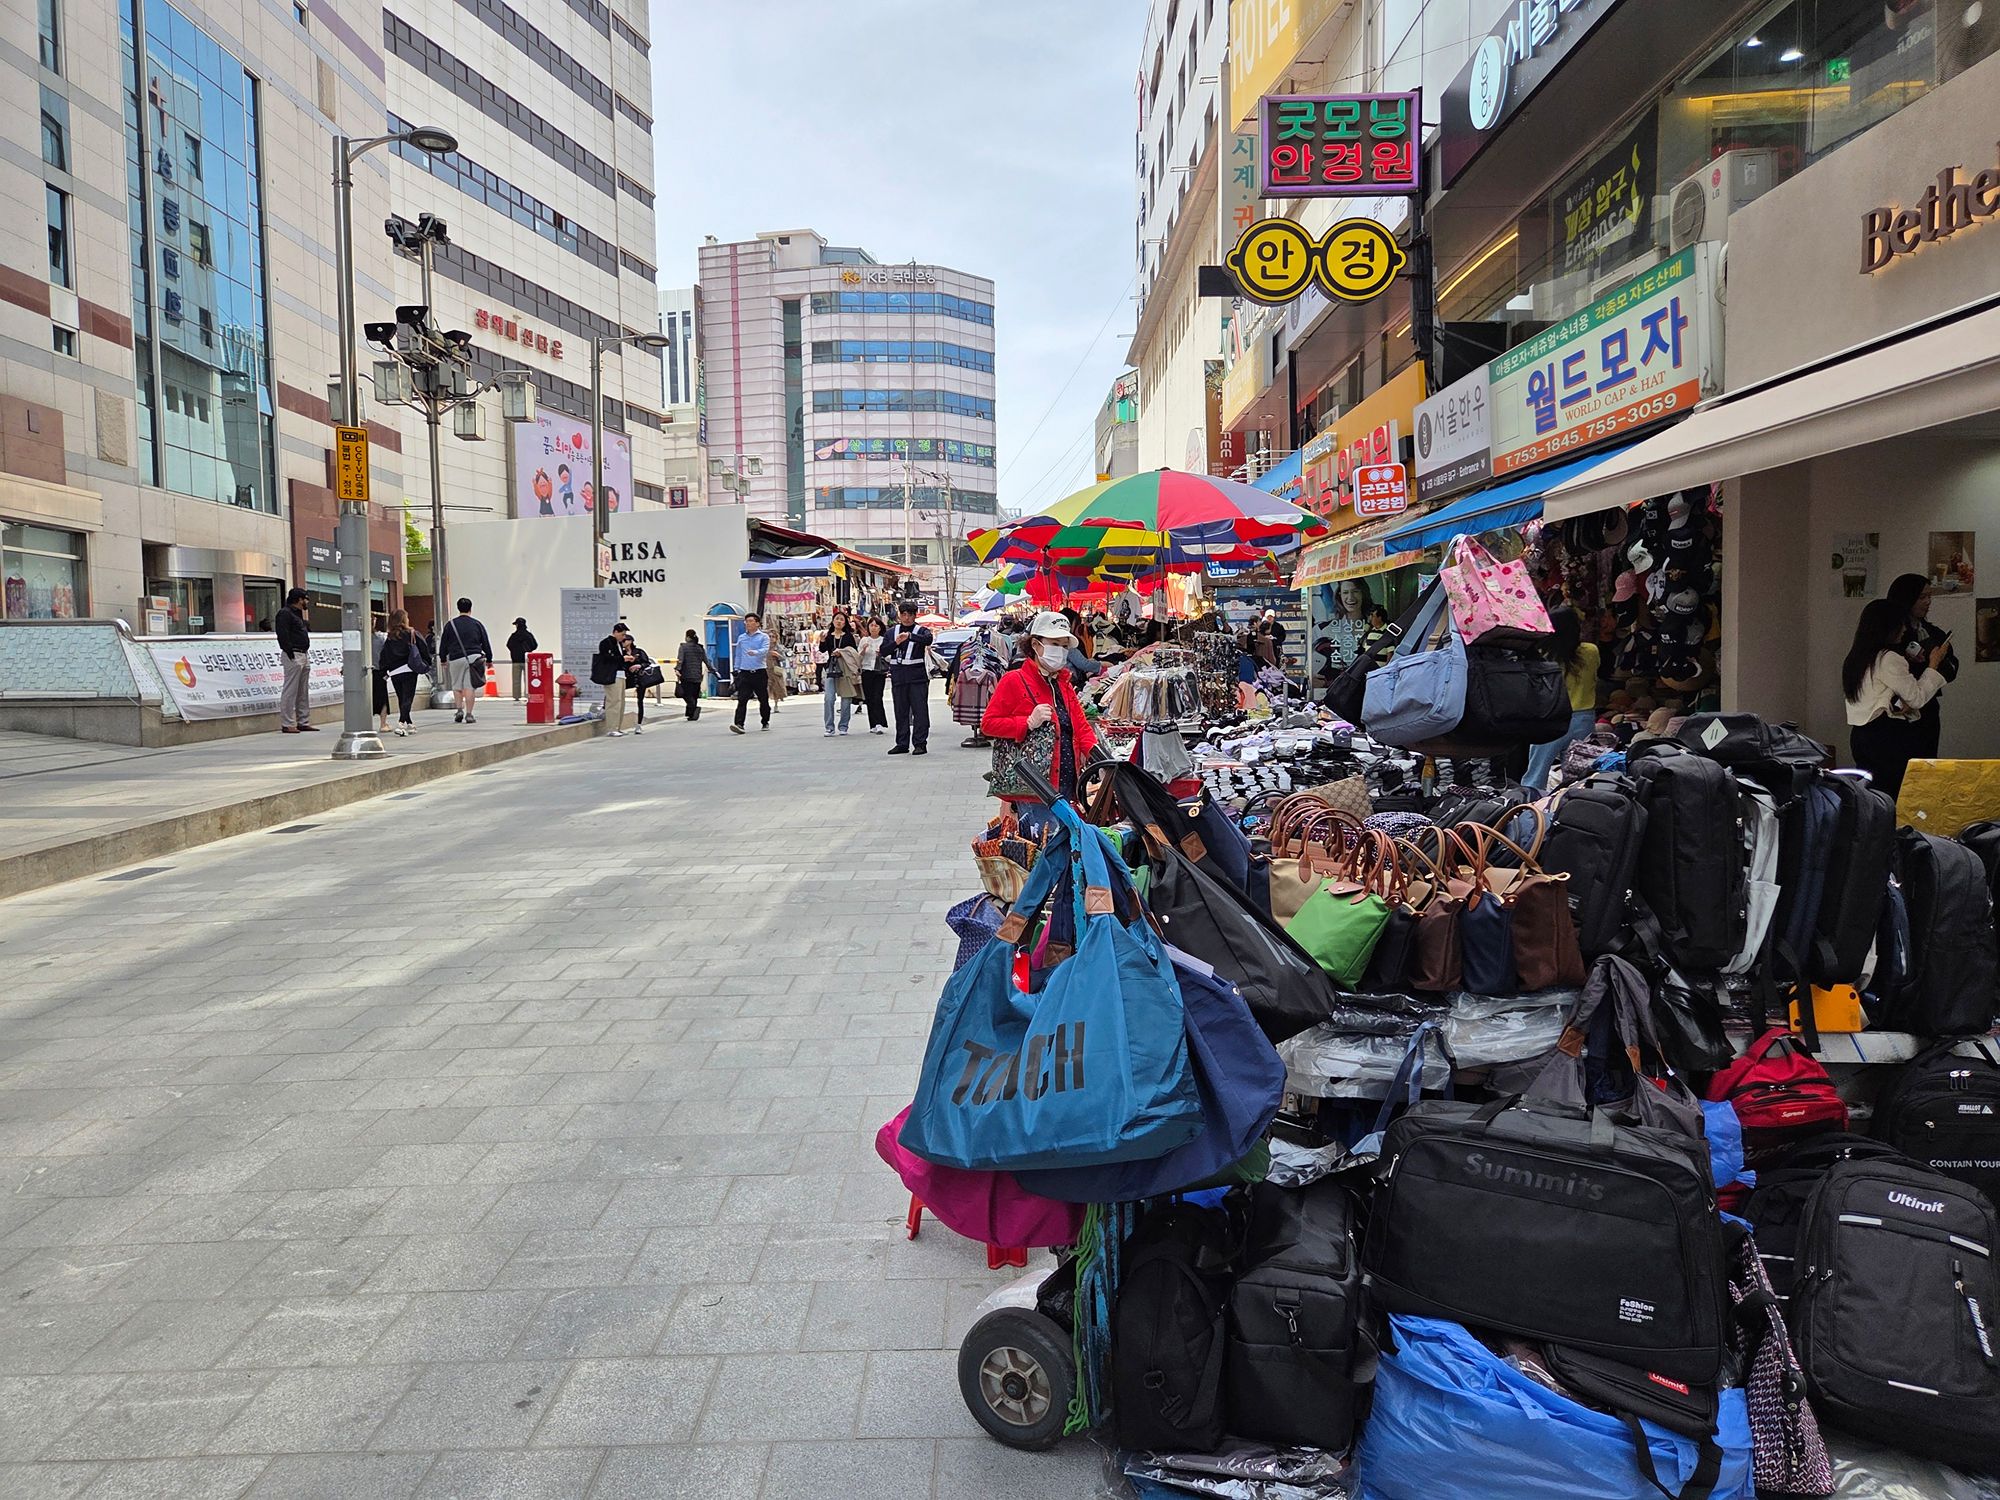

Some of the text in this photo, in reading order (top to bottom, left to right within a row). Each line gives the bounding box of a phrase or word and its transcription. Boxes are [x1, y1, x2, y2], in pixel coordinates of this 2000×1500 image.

[1503, 0, 1584, 67] 서울
[1277, 100, 1406, 140] 굿모닝
[1271, 141, 1412, 184] 안경원
[1231, 137, 1255, 231] 시계·귀
[1712, 189, 1721, 199] LG
[1565, 166, 1628, 245] 매장 입구
[1859, 141, 2000, 275] Bethe
[1257, 239, 1375, 279] 안경
[868, 272, 935, 284] KB 국민은행
[476, 309, 563, 360] 삼익패션타운
[1495, 313, 1589, 377] 아동모자·케쥬얼·숙녀용
[1526, 296, 1689, 436] 월드모자
[1434, 385, 1485, 438] 서울한우
[1564, 371, 1666, 422] WORLD CAP & HAT
[1505, 393, 1678, 468] T.753-1845. 755-3059
[1460, 462, 1479, 477] Entrance
[1361, 482, 1404, 497] 굿모닝
[1362, 497, 1405, 511] 안경원
[336, 551, 342, 564] P
[611, 541, 666, 561] IESA
[609, 569, 665, 584] ARKING
[1330, 619, 1366, 633] 일상의
[199, 653, 246, 672] 남대문시장
[1330, 649, 1355, 663] 순간
[263, 684, 283, 696] 죄송합니
[1463, 1153, 1604, 1201] Summits
[1930, 1159, 1973, 1168] CONTAIN
[1887, 1190, 1945, 1213] Ultimit
